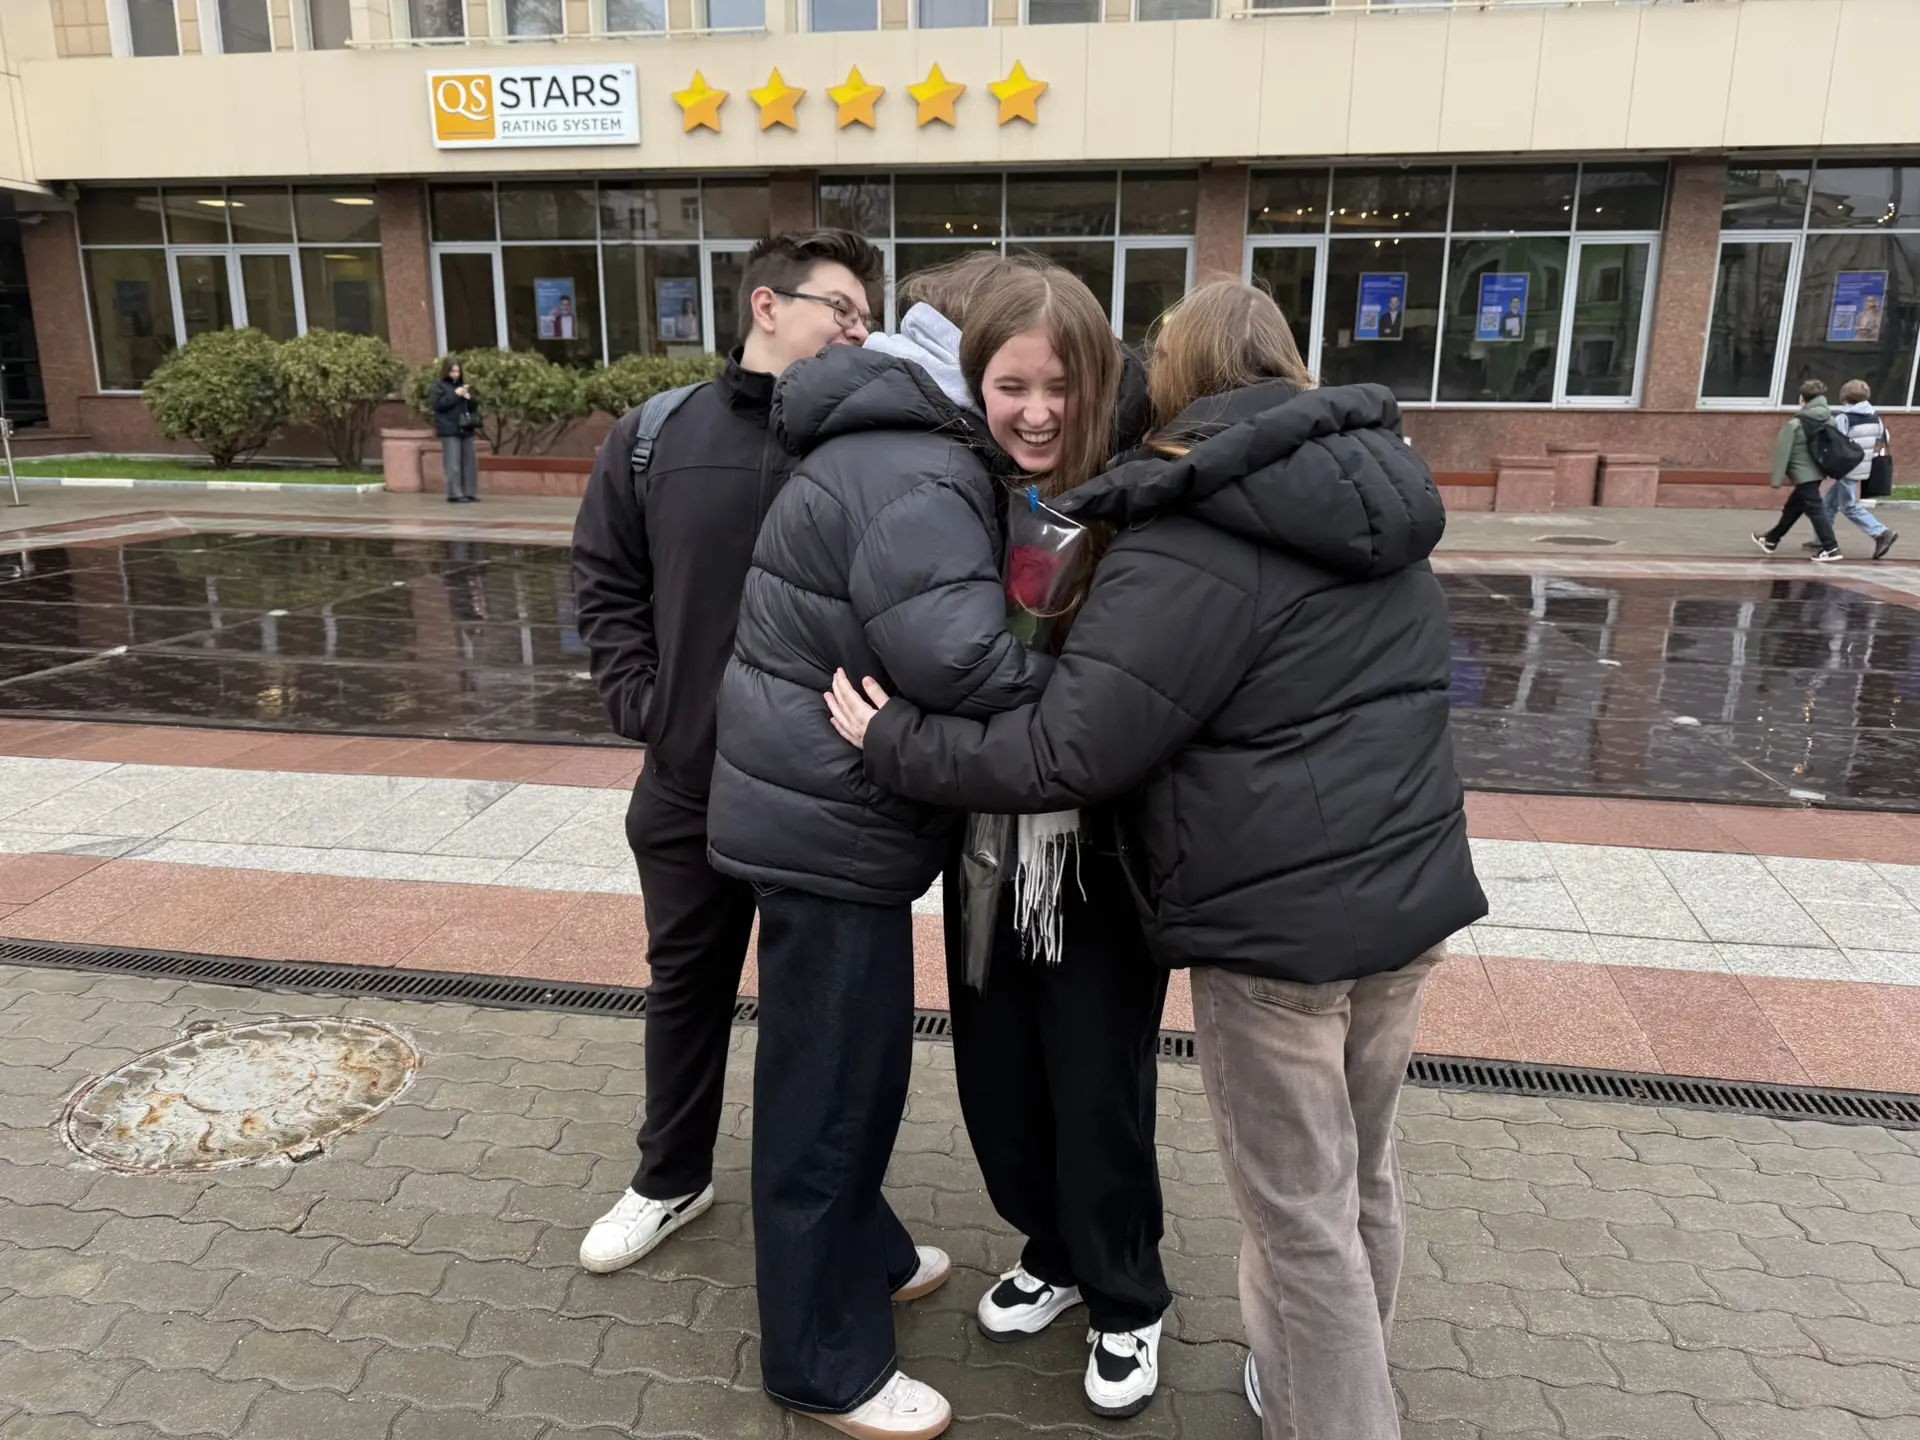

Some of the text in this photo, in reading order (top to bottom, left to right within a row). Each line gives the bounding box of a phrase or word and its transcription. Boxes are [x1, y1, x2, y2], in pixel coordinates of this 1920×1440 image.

[437, 79, 490, 121] QS
[500, 74, 620, 109] STARS
[502, 118, 622, 133] RATING SYSTEM
